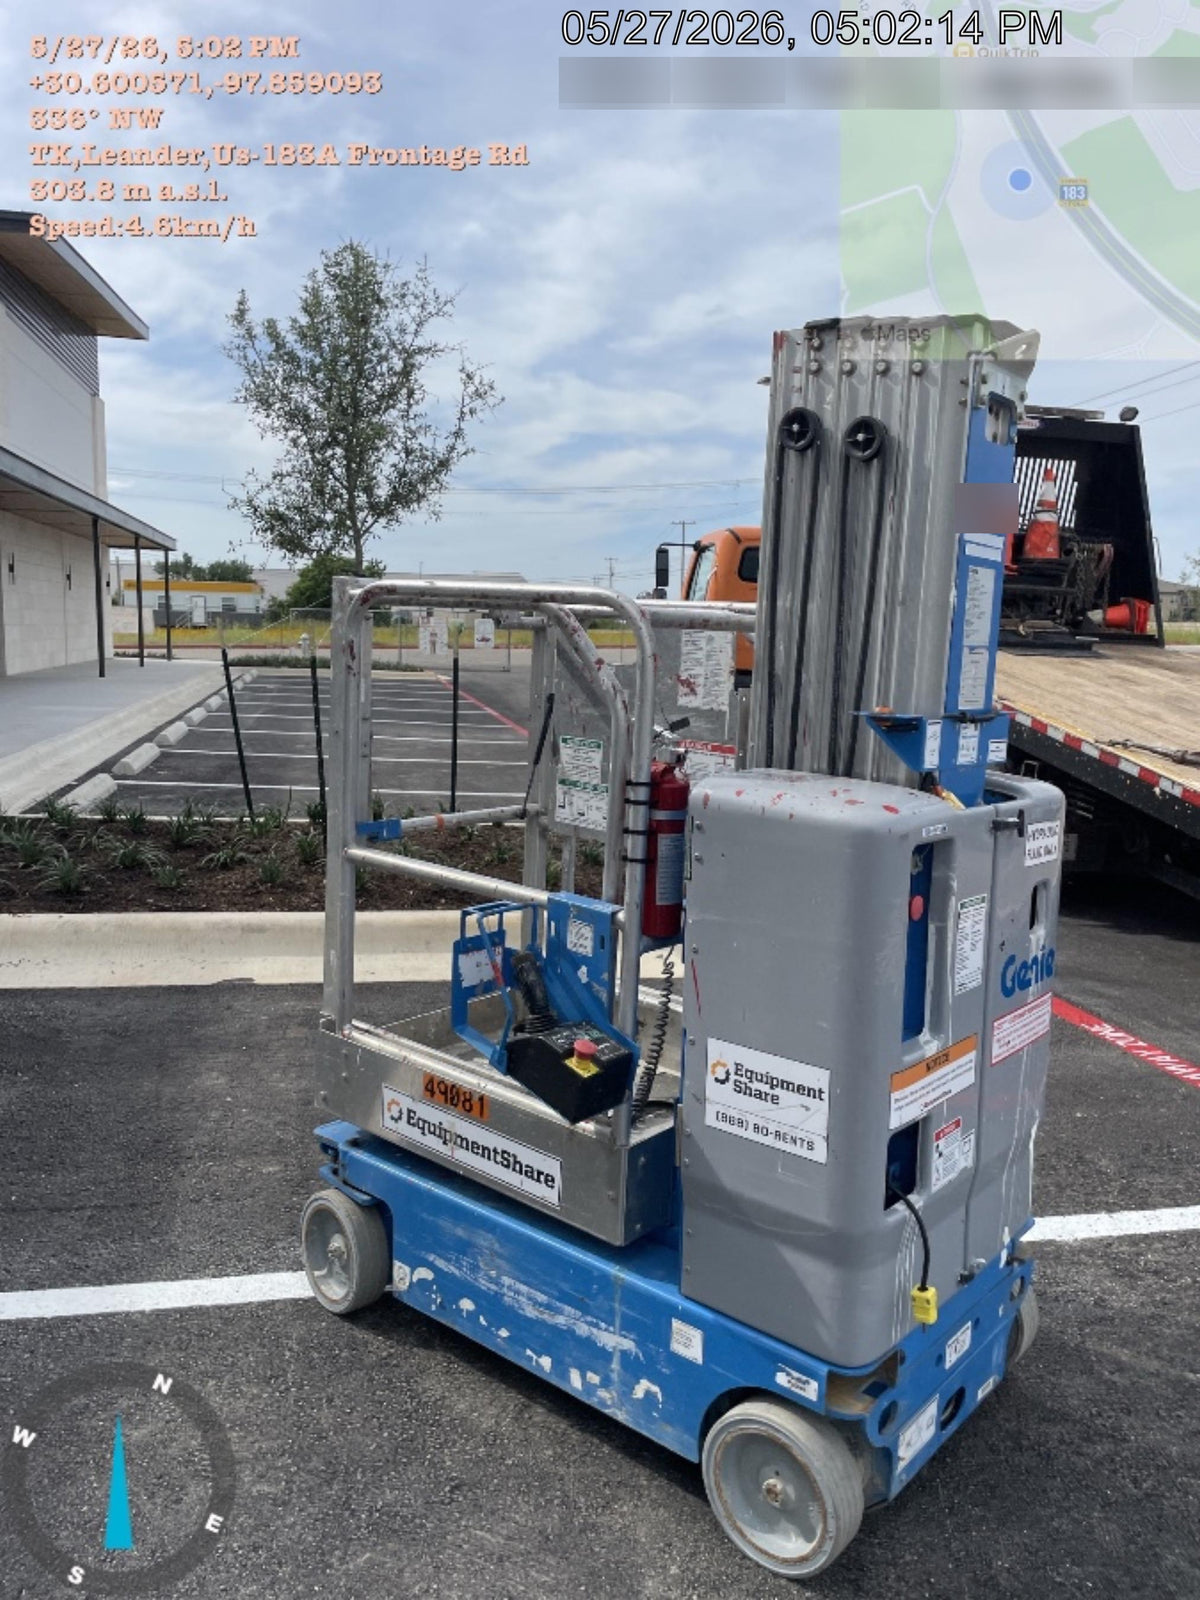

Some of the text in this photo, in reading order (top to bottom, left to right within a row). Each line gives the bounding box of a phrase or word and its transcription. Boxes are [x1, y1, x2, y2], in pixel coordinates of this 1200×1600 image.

[1000, 944, 1055, 998] Genie
[423, 1076, 486, 1119] 49081
[733, 1061, 826, 1101] Equipment
[733, 1078, 780, 1105] Share
[406, 1107, 556, 1189] EquipmentShare
